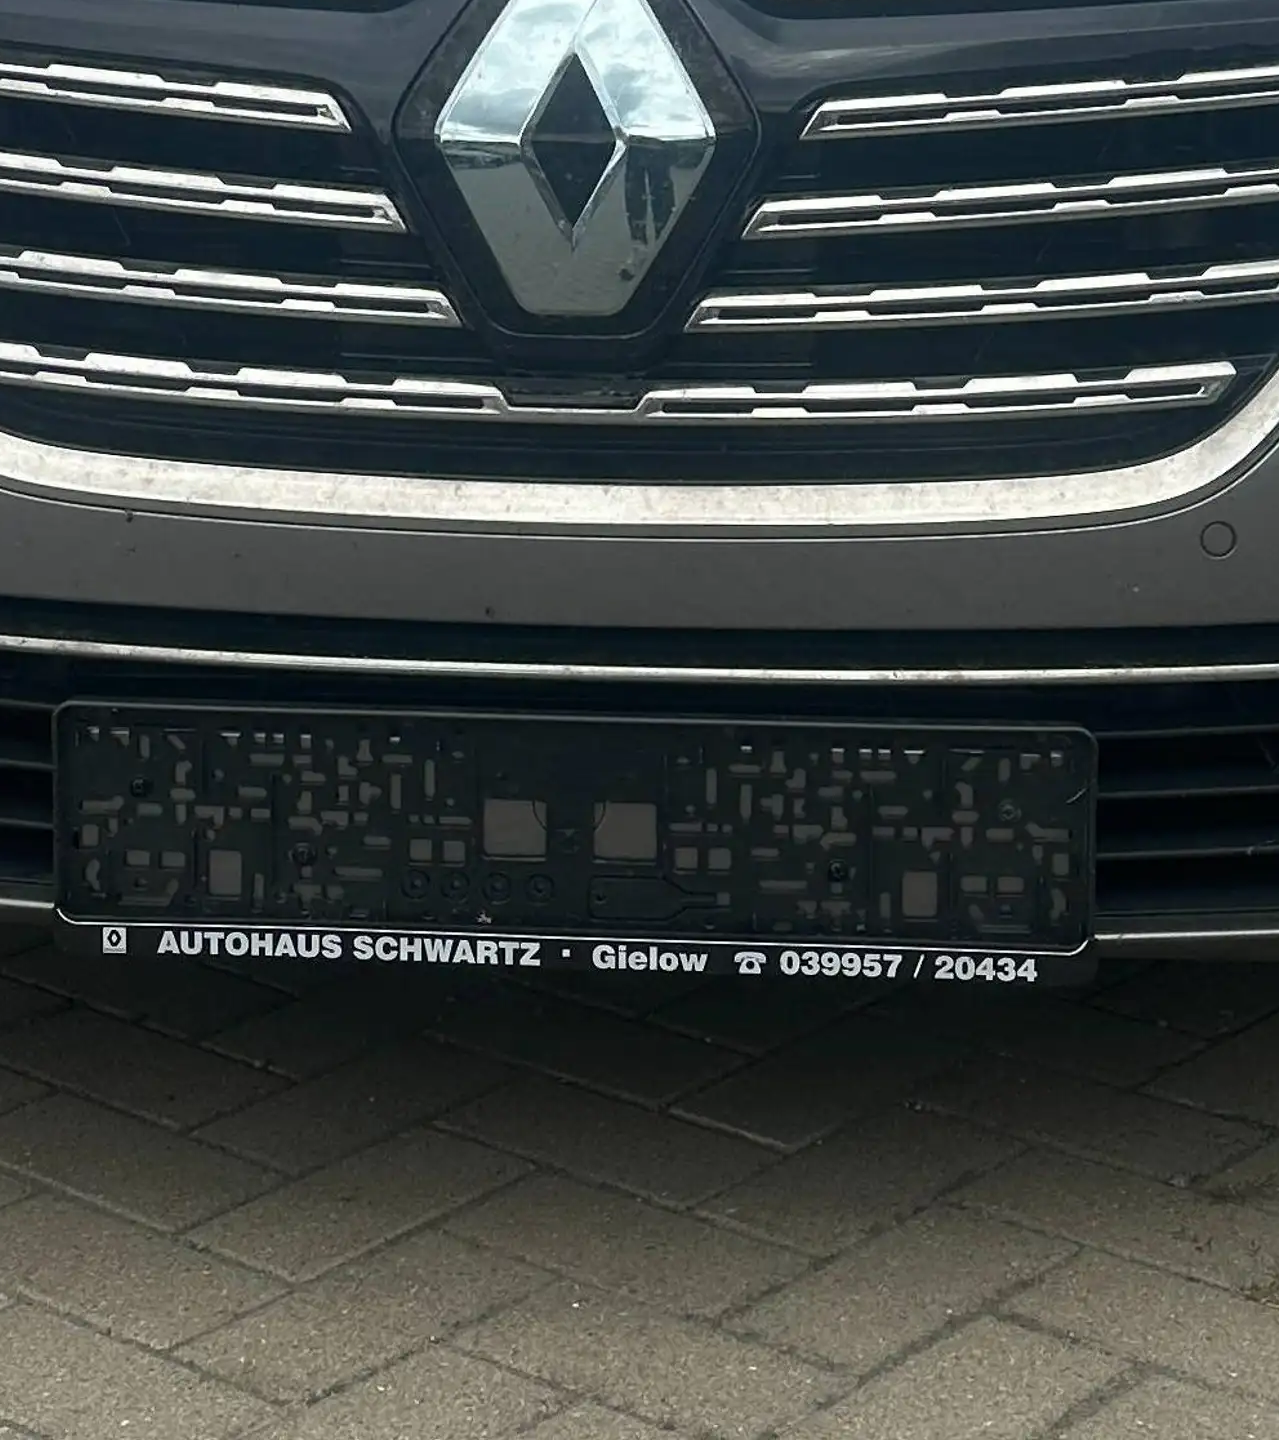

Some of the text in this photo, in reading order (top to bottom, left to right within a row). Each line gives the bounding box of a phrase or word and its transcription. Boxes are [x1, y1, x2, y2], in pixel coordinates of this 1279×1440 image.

[157, 929, 343, 959] AUTOHAUS
[352, 934, 542, 966] SCHWARTZ
[592, 944, 709, 973] Gielow
[779, 949, 903, 979] 039957
[934, 954, 1038, 982] 20434
